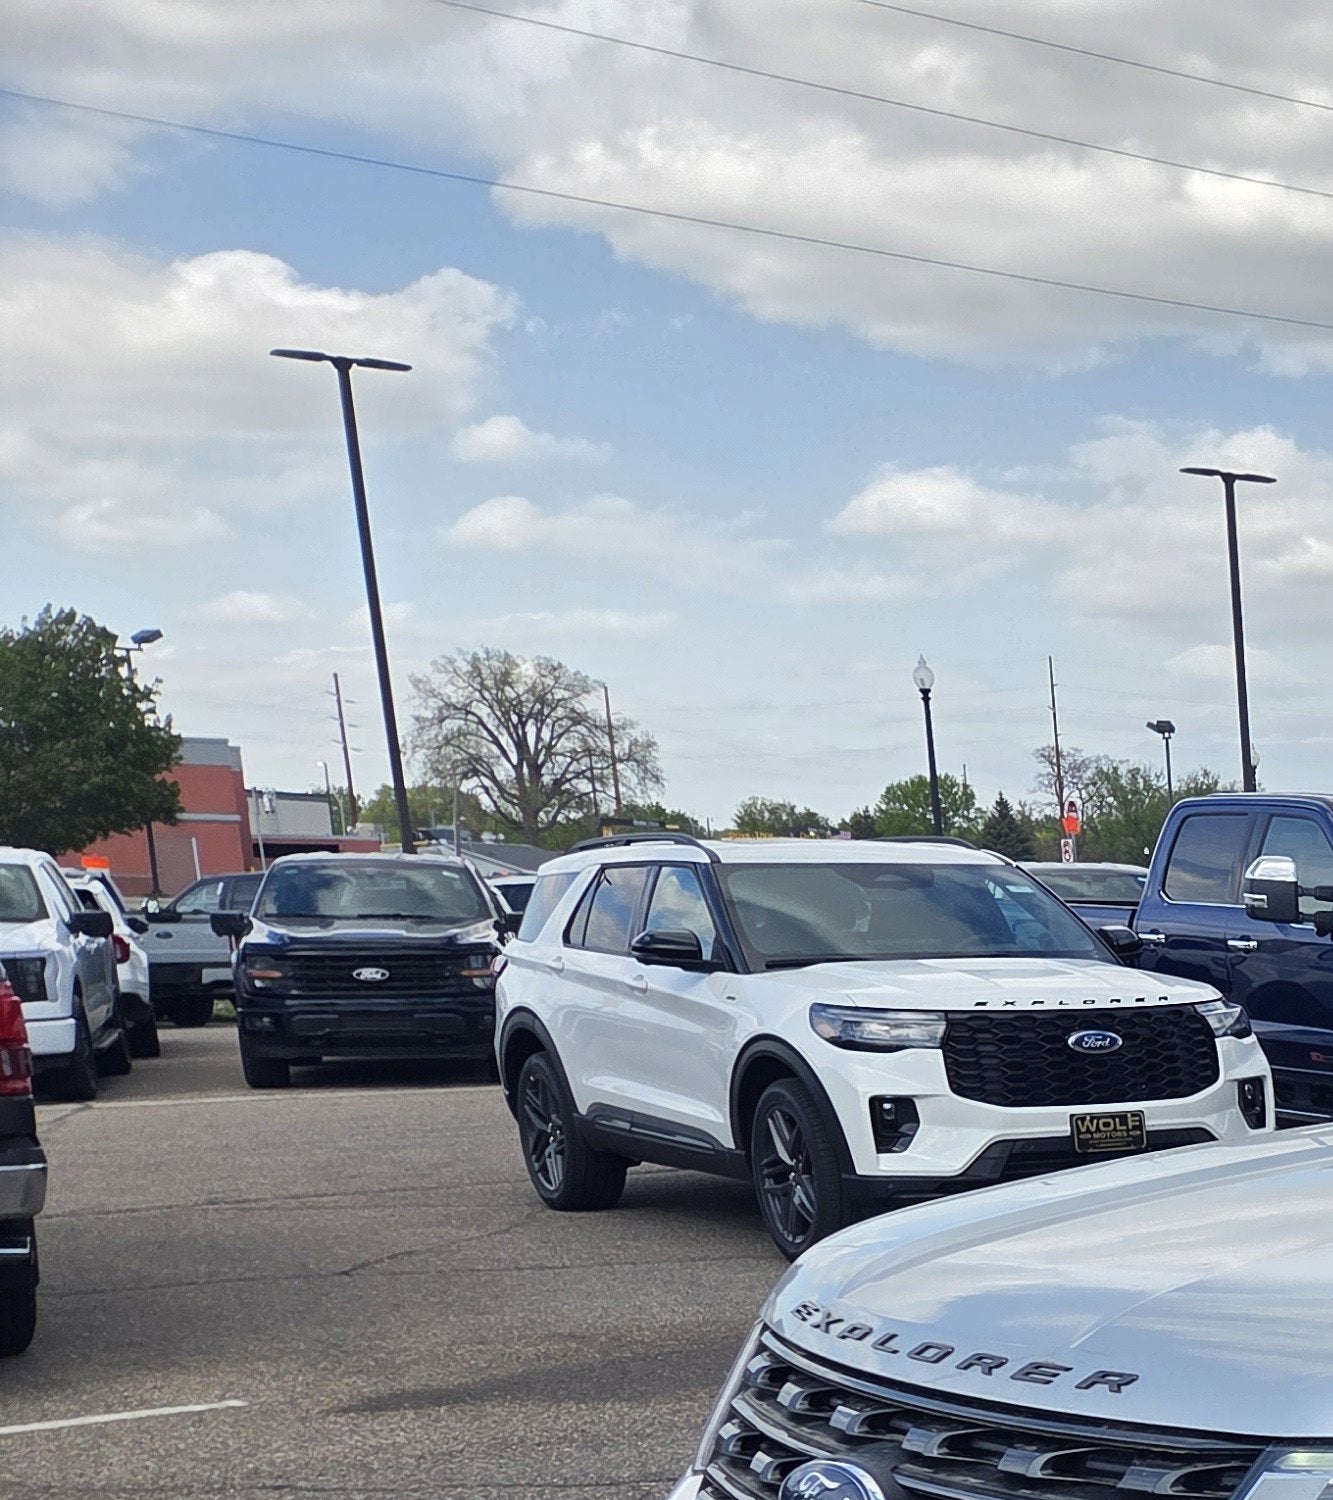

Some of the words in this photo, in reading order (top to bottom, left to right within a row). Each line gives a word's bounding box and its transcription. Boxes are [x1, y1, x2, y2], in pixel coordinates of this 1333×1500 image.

[1081, 1034, 1112, 1049] Ford
[1077, 1113, 1140, 1133] WOLF
[1093, 1130, 1127, 1139] MOTORS
[790, 1300, 1140, 1394] EXPLORER
